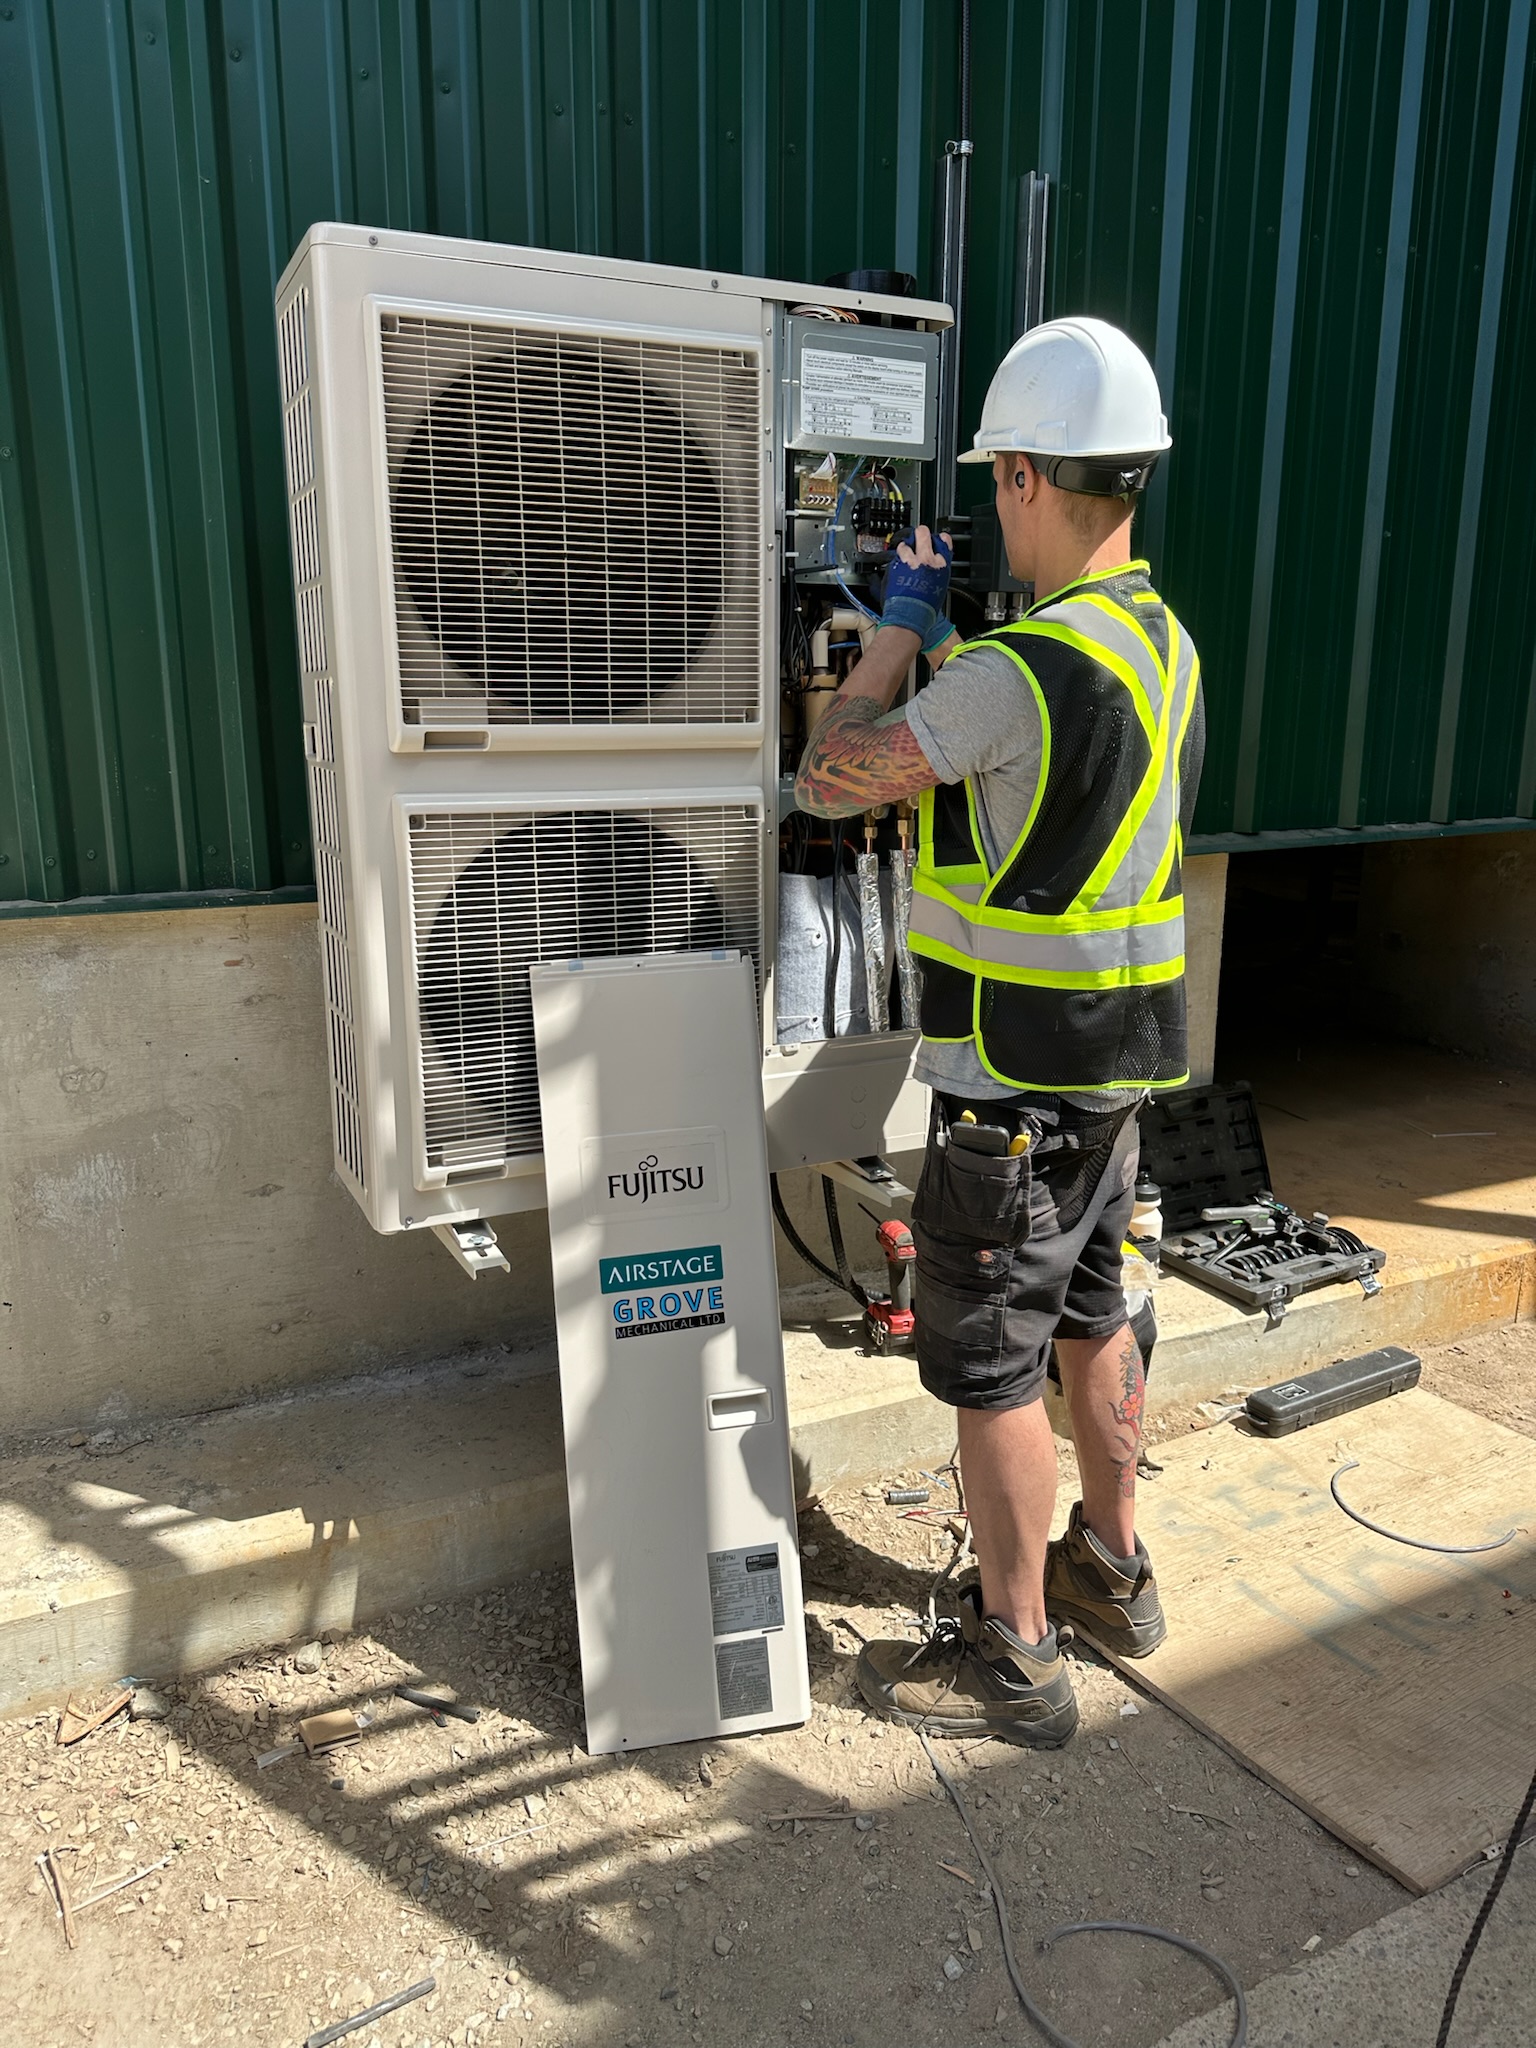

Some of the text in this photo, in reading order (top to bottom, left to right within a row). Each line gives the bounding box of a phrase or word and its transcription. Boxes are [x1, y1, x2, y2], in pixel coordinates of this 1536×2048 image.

[608, 1155, 704, 1204] FUJITSU
[608, 1255, 716, 1285] AIRSTAGE
[613, 1286, 724, 1323] GROVE
[616, 1319, 695, 1338] MECHANICAL
